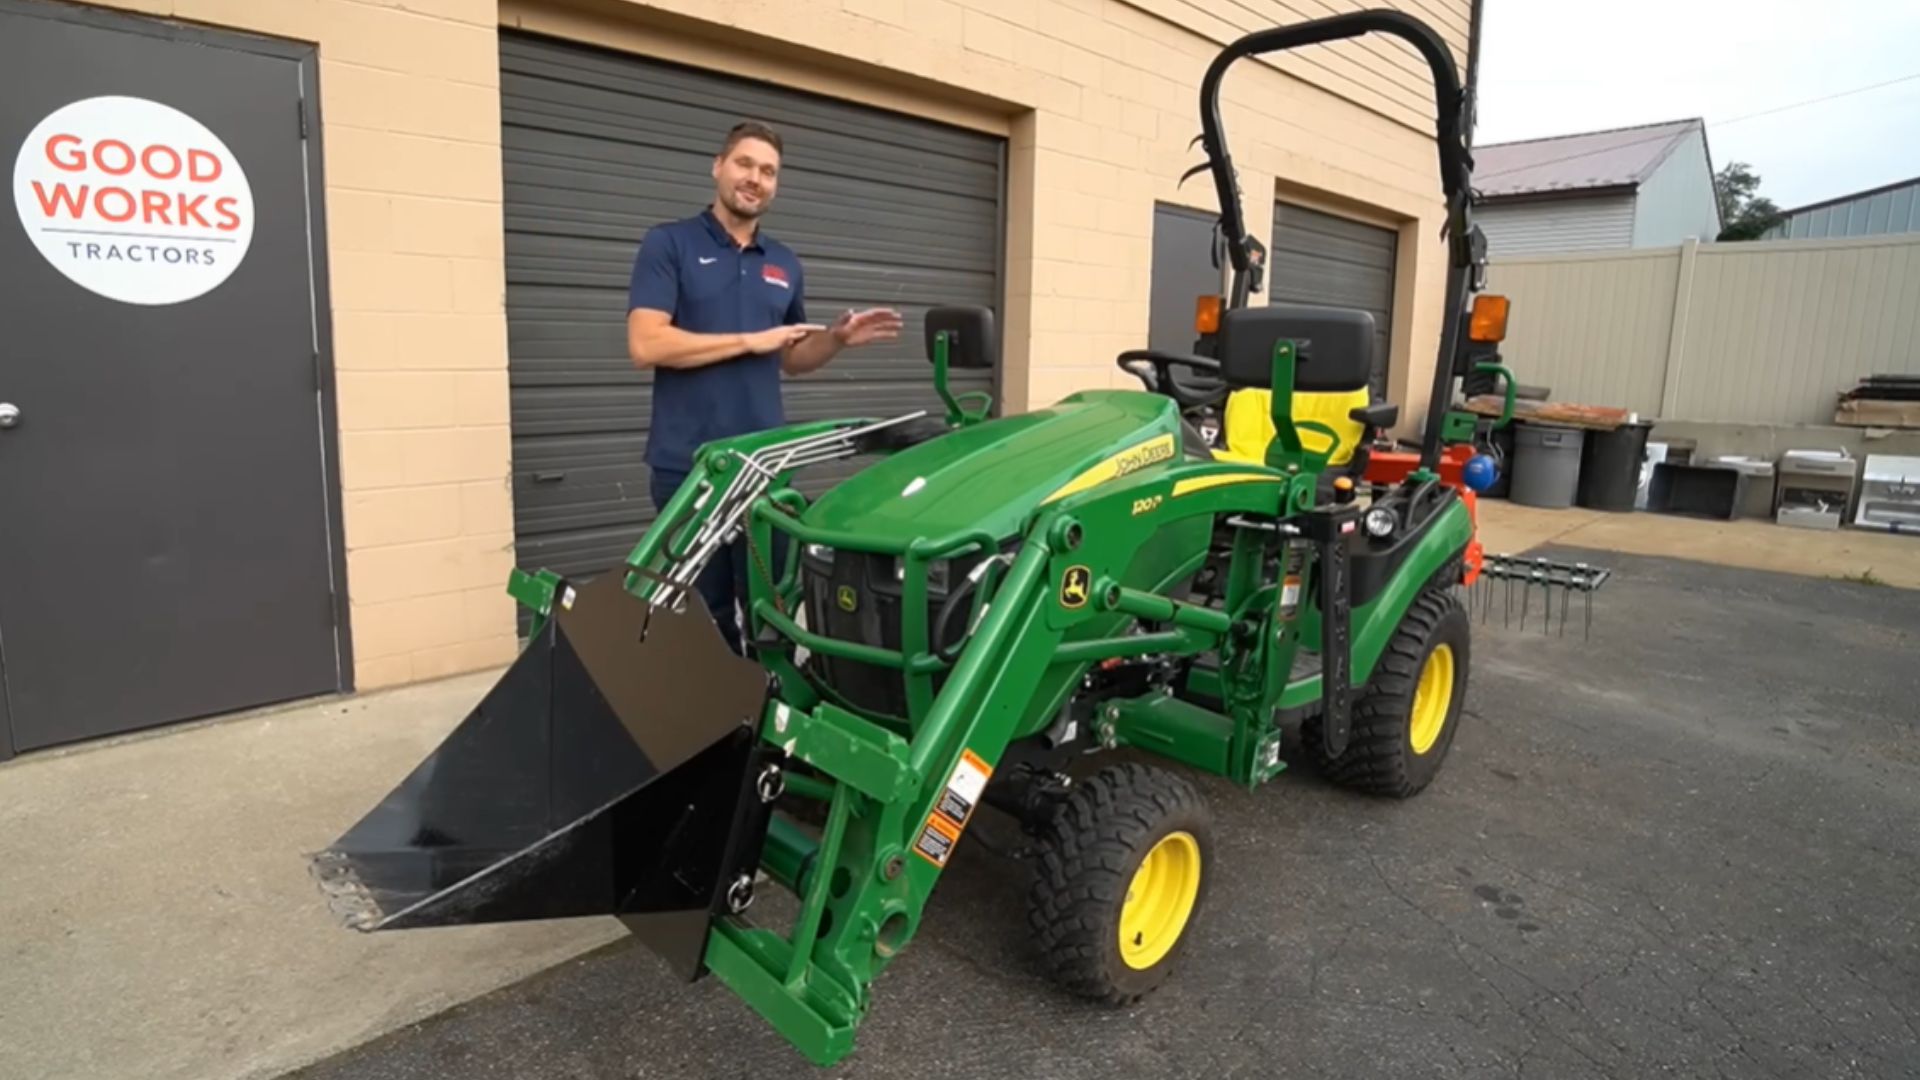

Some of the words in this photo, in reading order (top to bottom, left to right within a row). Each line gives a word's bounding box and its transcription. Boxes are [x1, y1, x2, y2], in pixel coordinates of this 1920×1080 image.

[45, 133, 222, 183] GOOD
[31, 180, 241, 231] WORKS
[67, 242, 215, 265] TRACTORS
[1115, 454, 1142, 477] JOHN
[1142, 444, 1171, 466] DEERE
